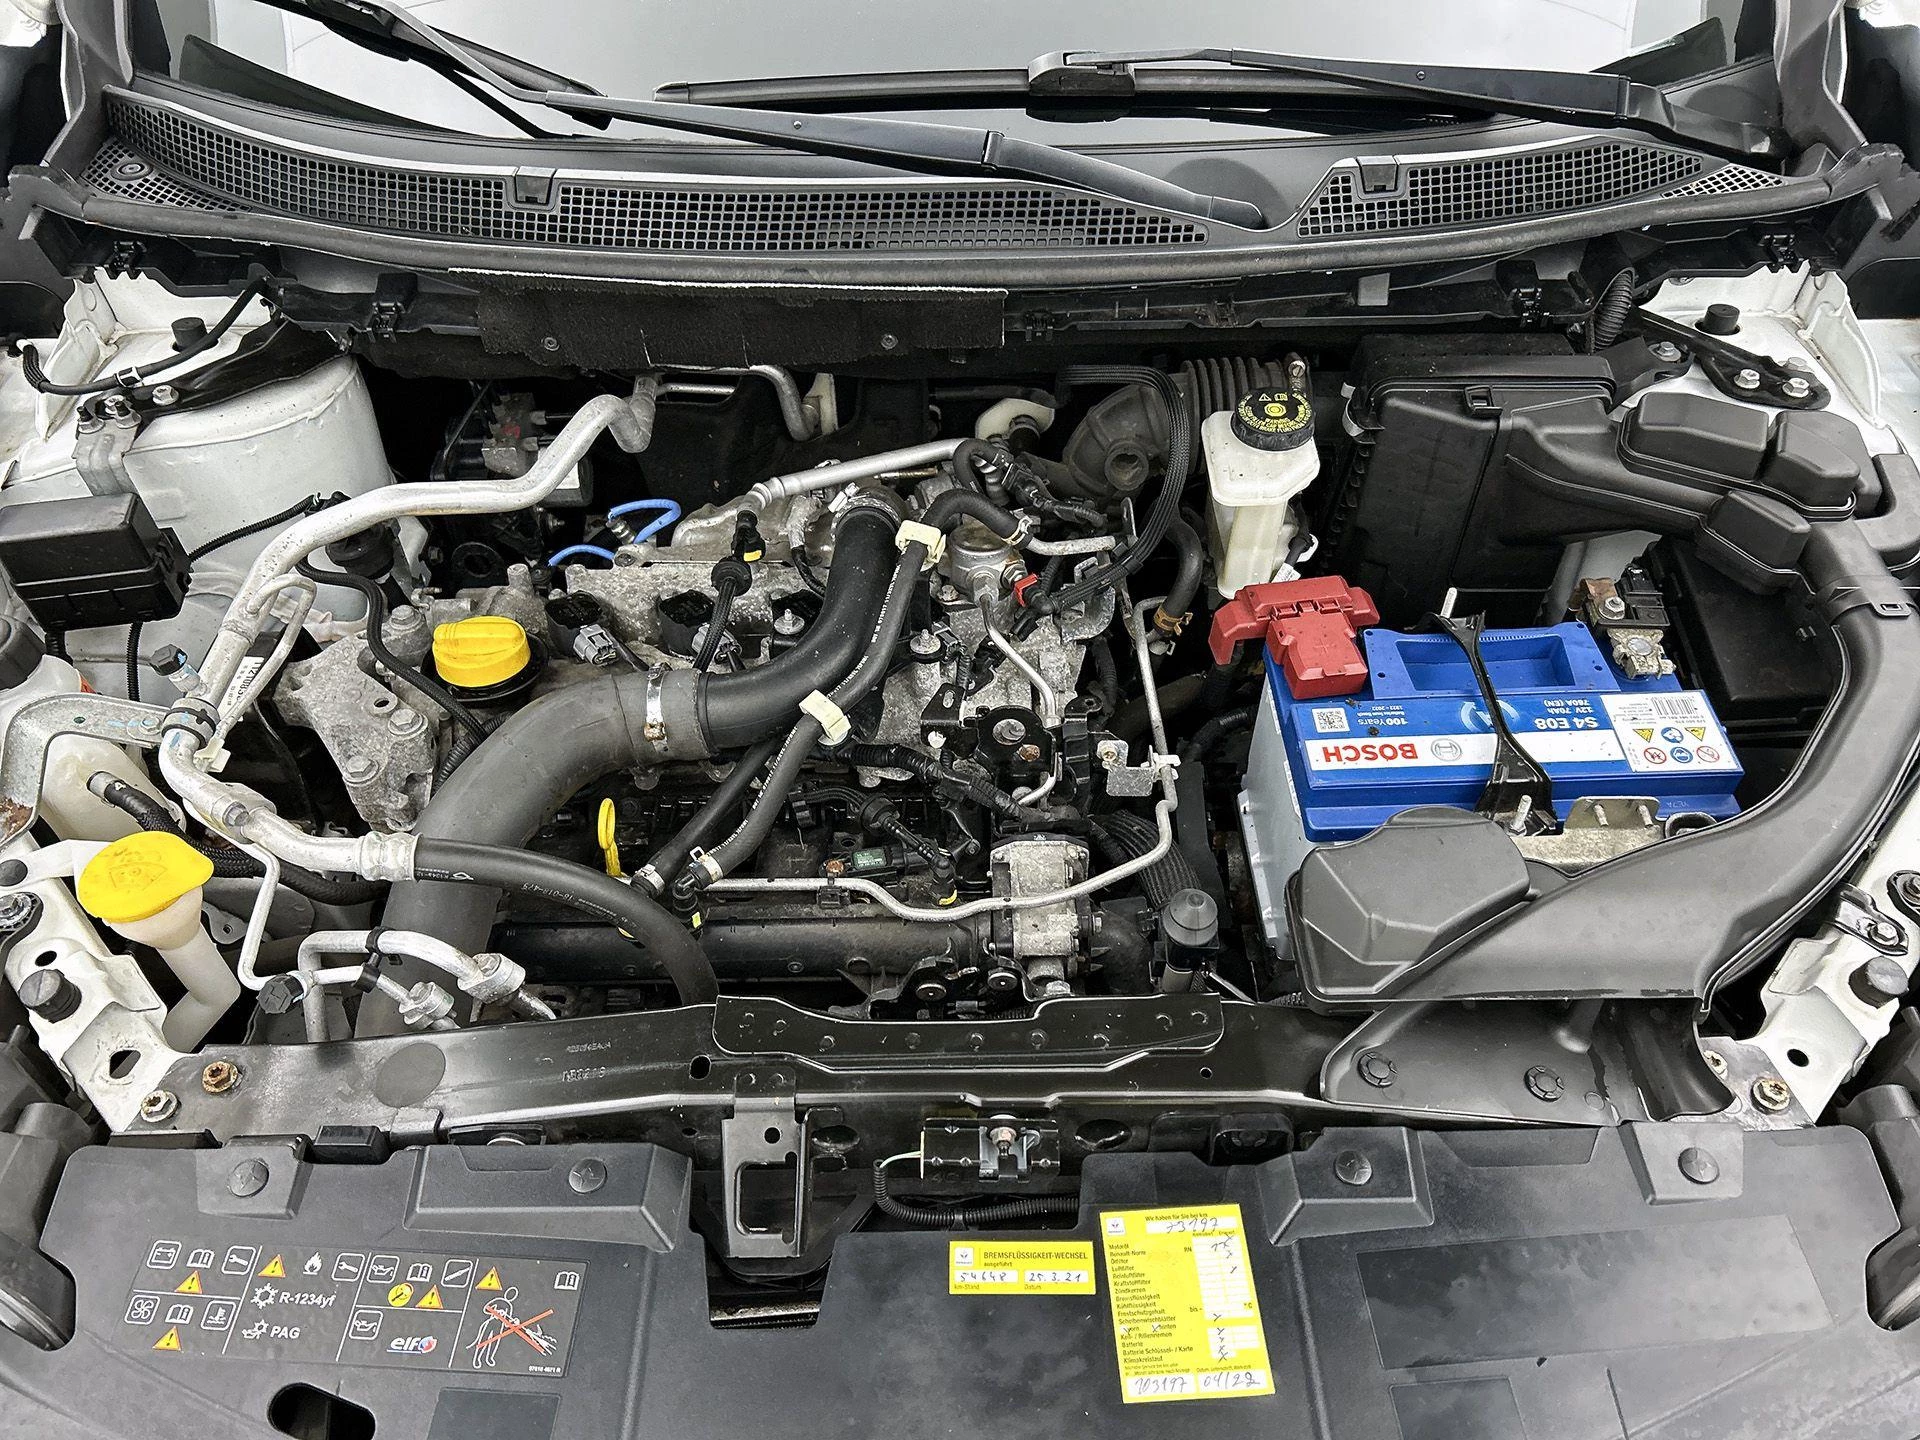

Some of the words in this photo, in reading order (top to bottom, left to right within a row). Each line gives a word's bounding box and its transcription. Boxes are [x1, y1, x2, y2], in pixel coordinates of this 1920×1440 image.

[1534, 717, 1570, 730] E08
[1572, 716, 1599, 729] S4
[1322, 743, 1418, 762] BOSCH
[984, 1250, 1088, 1260] BREMSFLÜSSIGKEIT-WECHSEL
[279, 1292, 336, 1308] R-1234yf
[270, 1326, 300, 1339] PAG
[390, 1337, 420, 1351] elf
